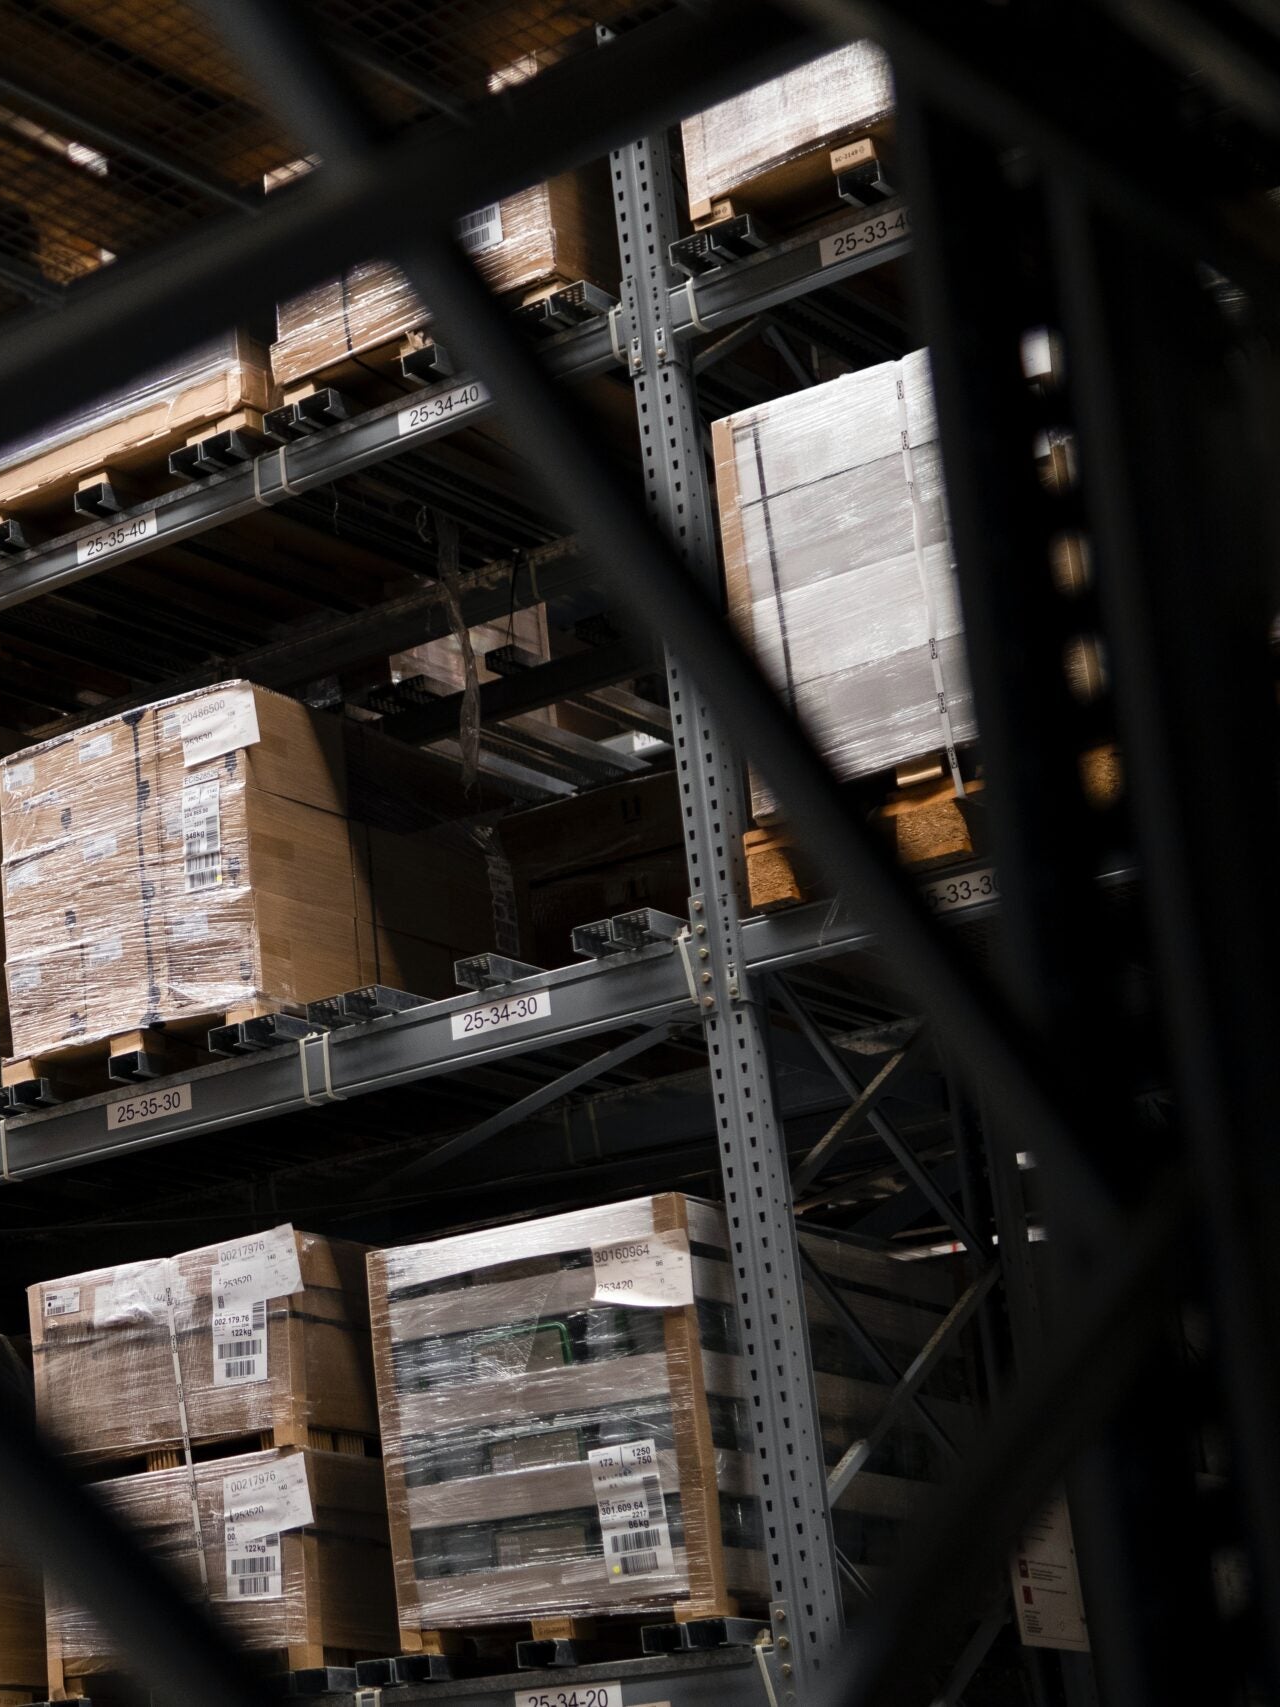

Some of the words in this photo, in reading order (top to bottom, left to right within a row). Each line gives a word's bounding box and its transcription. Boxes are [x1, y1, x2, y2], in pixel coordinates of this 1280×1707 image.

[409, 385, 479, 427] 25-34-40
[86, 519, 147, 556] 25-35-40
[925, 875, 1001, 908] 5-33-3
[463, 997, 538, 1032] 25-34-30
[117, 1091, 180, 1123] 25-35-30
[220, 1240, 266, 1263] 00217976
[593, 1243, 651, 1264] 30160964
[213, 1315, 250, 1327] 002.179.76
[231, 1328, 252, 1338] 122kg
[631, 1446, 651, 1457] 1250
[637, 1455, 653, 1465] 750
[599, 1458, 614, 1468] 172
[231, 1470, 276, 1493] 00217976
[601, 1501, 644, 1516] 301.609.64
[631, 1510, 647, 1519] 2217
[244, 1544, 266, 1553] 122kg
[528, 1688, 608, 1707] 25-34-20
